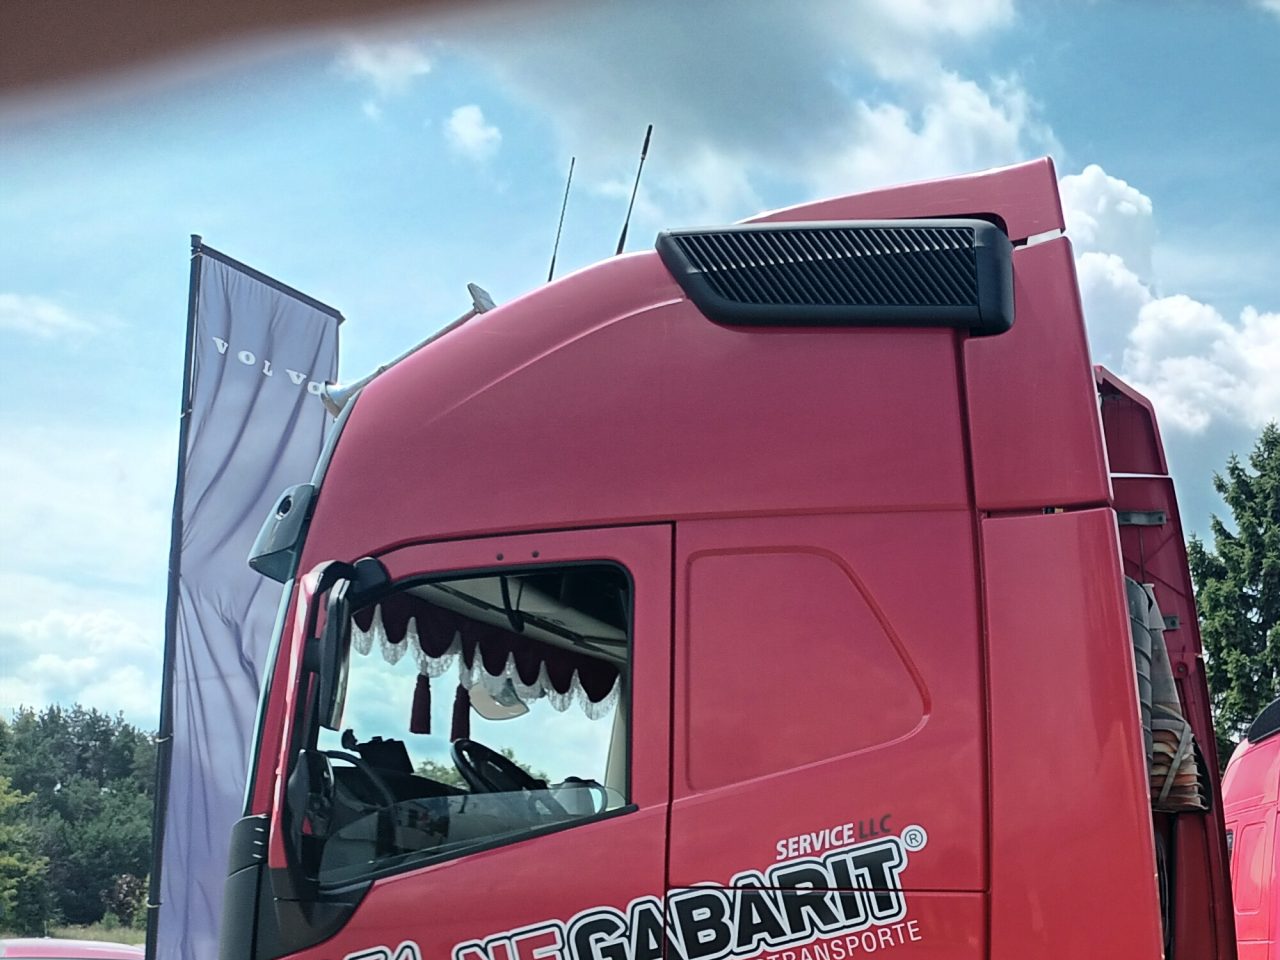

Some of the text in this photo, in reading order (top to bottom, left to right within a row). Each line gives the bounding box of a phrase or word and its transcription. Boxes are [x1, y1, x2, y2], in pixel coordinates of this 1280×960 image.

[211, 336, 324, 396] VOLVO
[776, 814, 892, 860] SERVICE LLC
